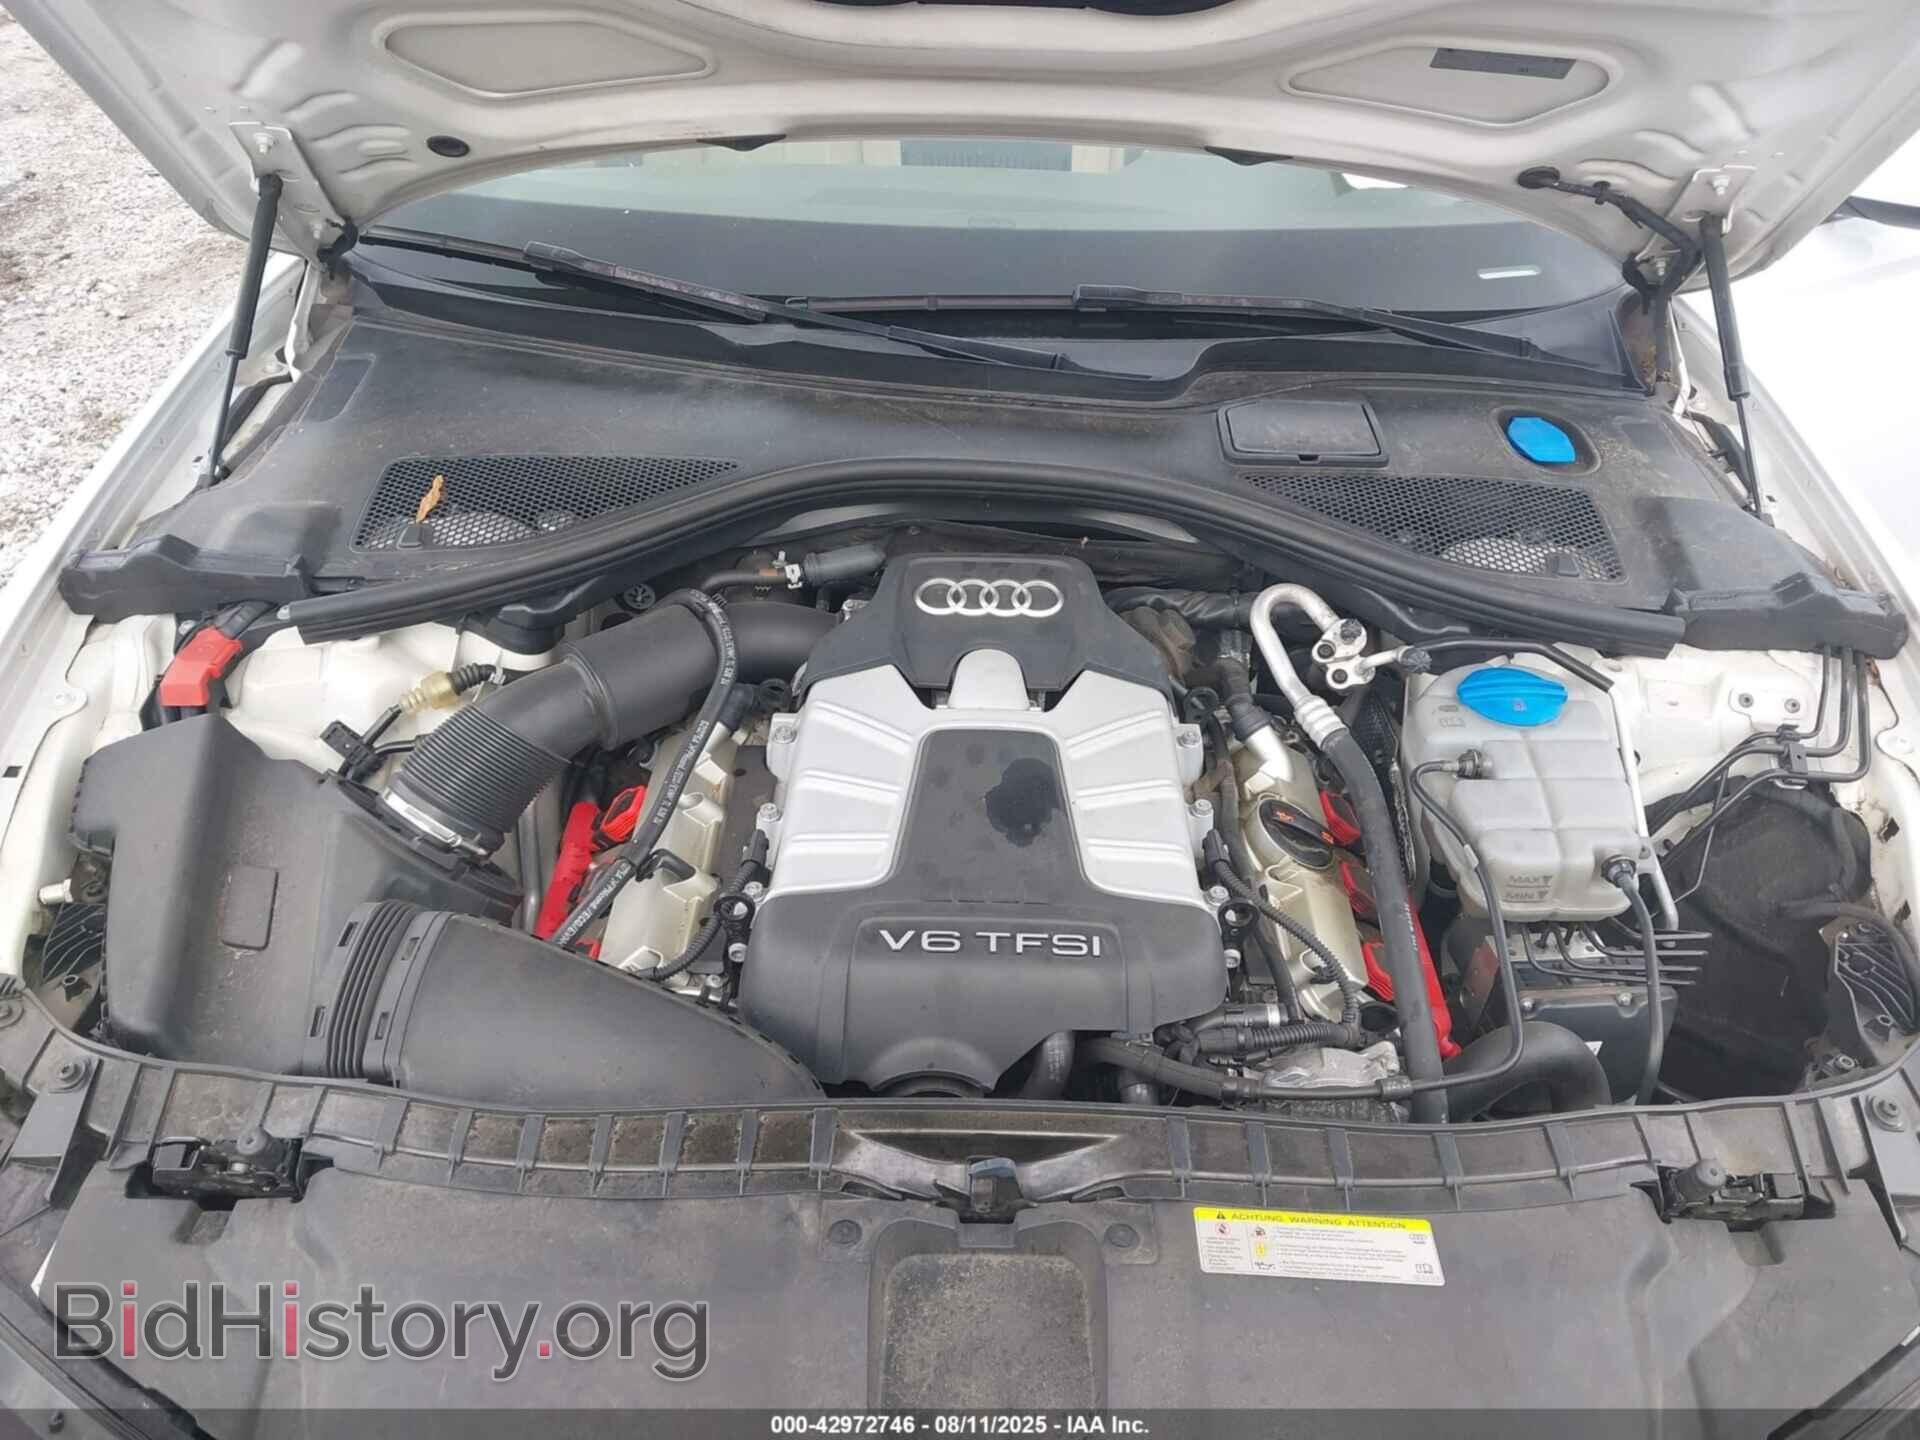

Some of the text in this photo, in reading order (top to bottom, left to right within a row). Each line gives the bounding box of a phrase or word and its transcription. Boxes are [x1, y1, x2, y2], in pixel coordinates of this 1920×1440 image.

[879, 929, 1101, 957] V6 TFSI
[1230, 1212, 1407, 1229] ACHTUNG WARNING ATTENTION
